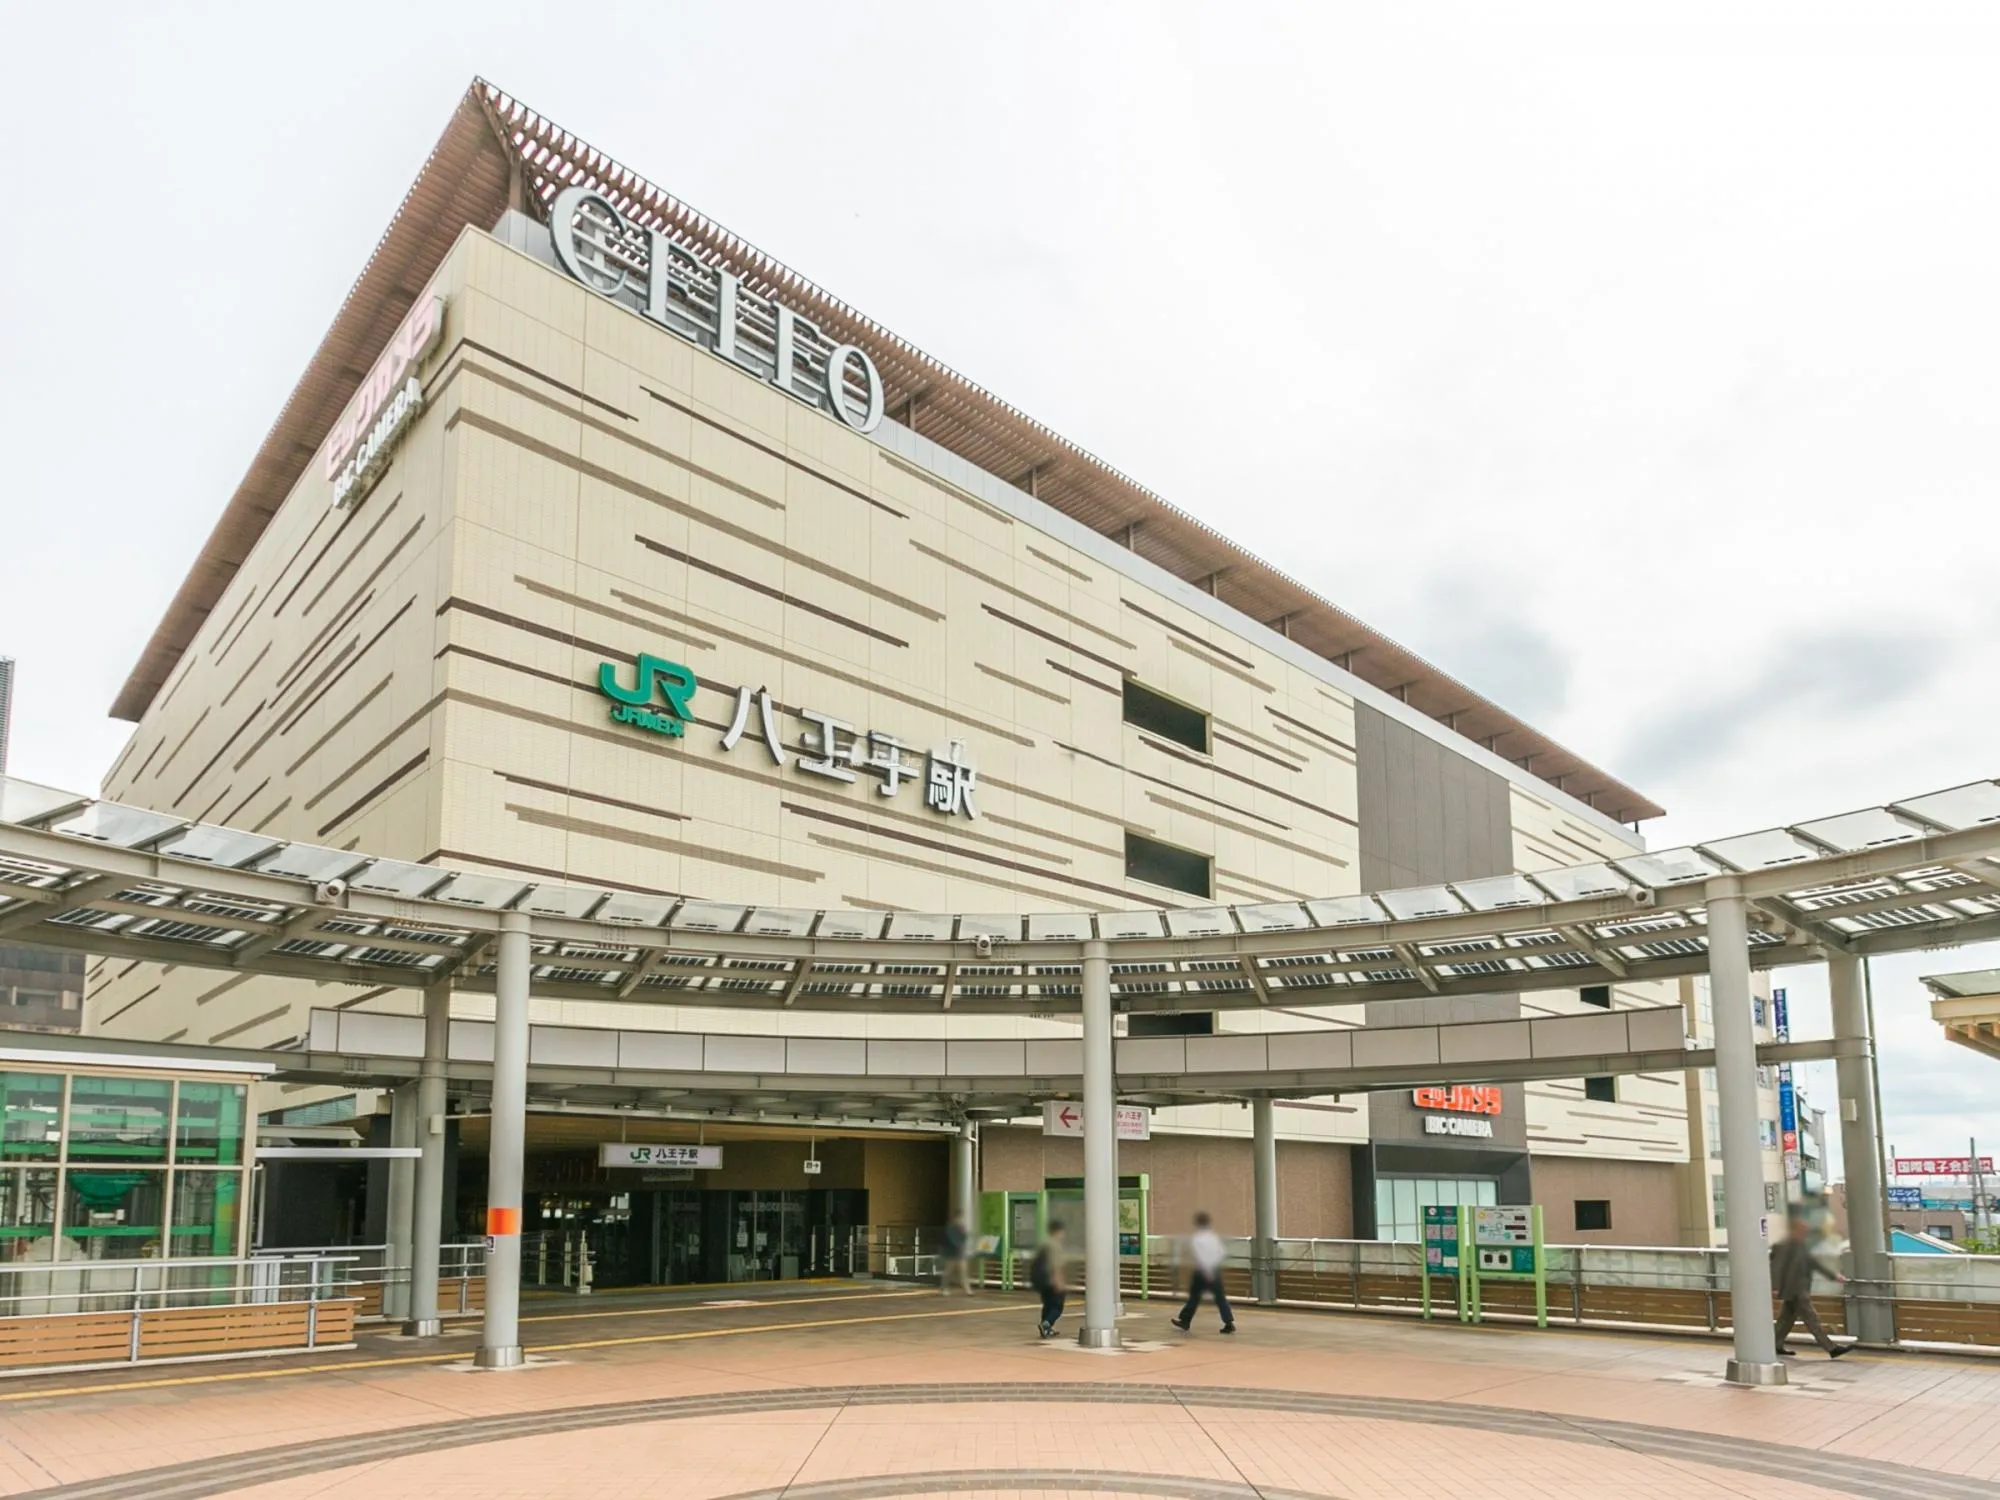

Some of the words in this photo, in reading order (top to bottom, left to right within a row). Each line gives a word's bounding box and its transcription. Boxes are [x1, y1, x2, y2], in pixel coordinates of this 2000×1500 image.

[549, 186, 885, 434] CELEO
[598, 652, 698, 724] JR
[719, 684, 977, 821] 八王子駅
[630, 1147, 651, 1160] JR
[655, 1148, 698, 1159] 八王子駅
